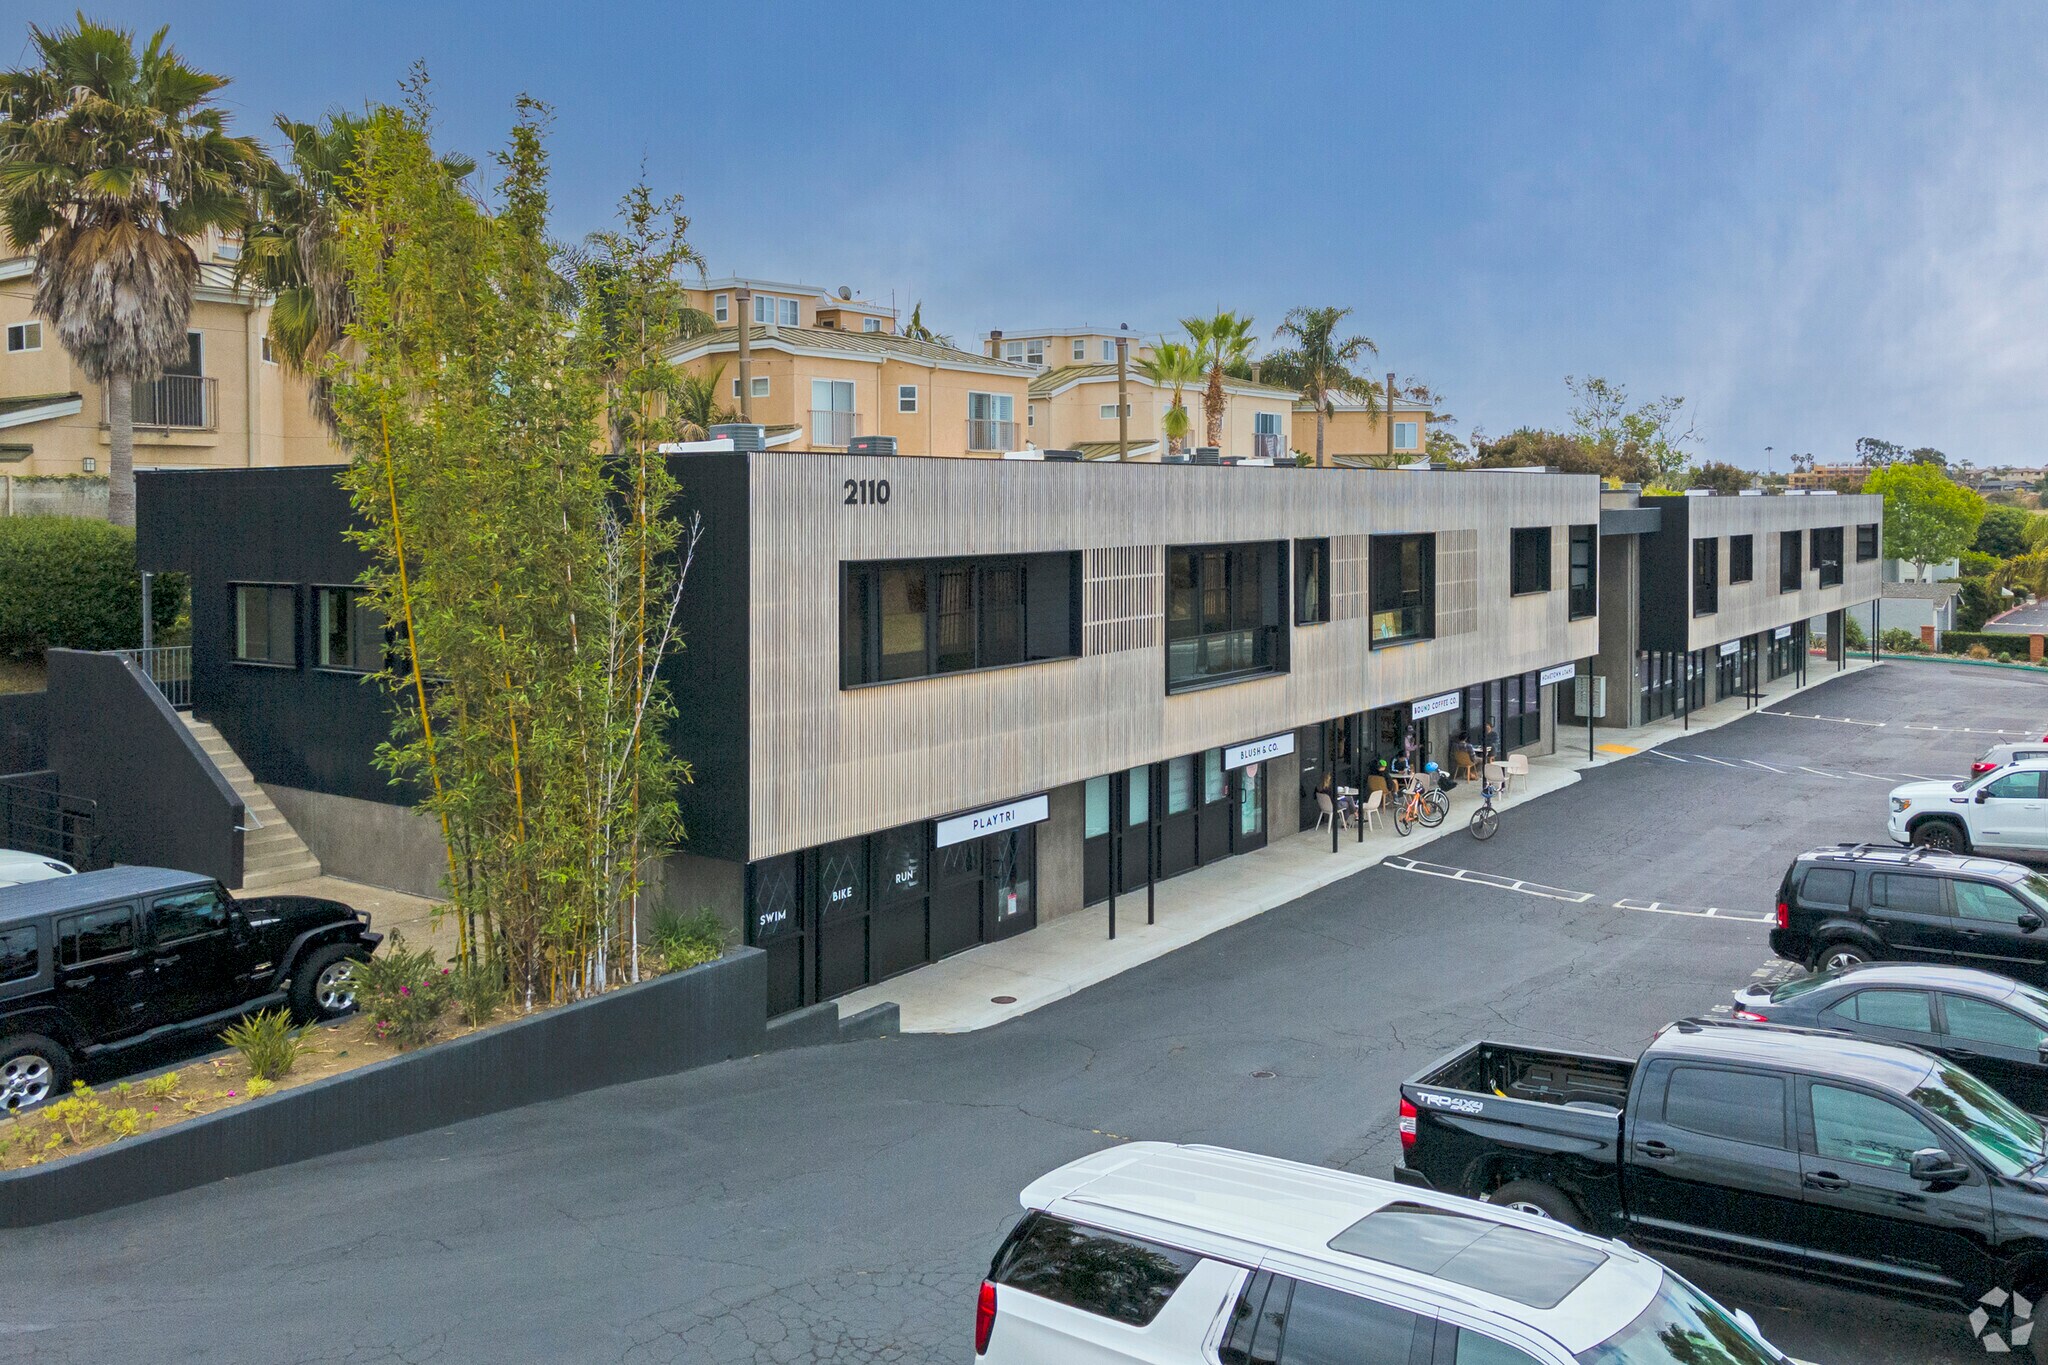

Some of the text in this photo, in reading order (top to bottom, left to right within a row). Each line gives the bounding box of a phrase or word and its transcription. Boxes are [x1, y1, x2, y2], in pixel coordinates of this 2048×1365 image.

[844, 479, 890, 504] 2110
[1432, 699, 1449, 710] COFFEE
[1240, 742, 1279, 760] BLUSH & CO.
[973, 810, 1015, 830] PLAYTRI
[895, 870, 914, 884] RUN
[832, 886, 853, 902] BIKE
[759, 909, 787, 926] SWIM
[1416, 1091, 1452, 1107] TRD
